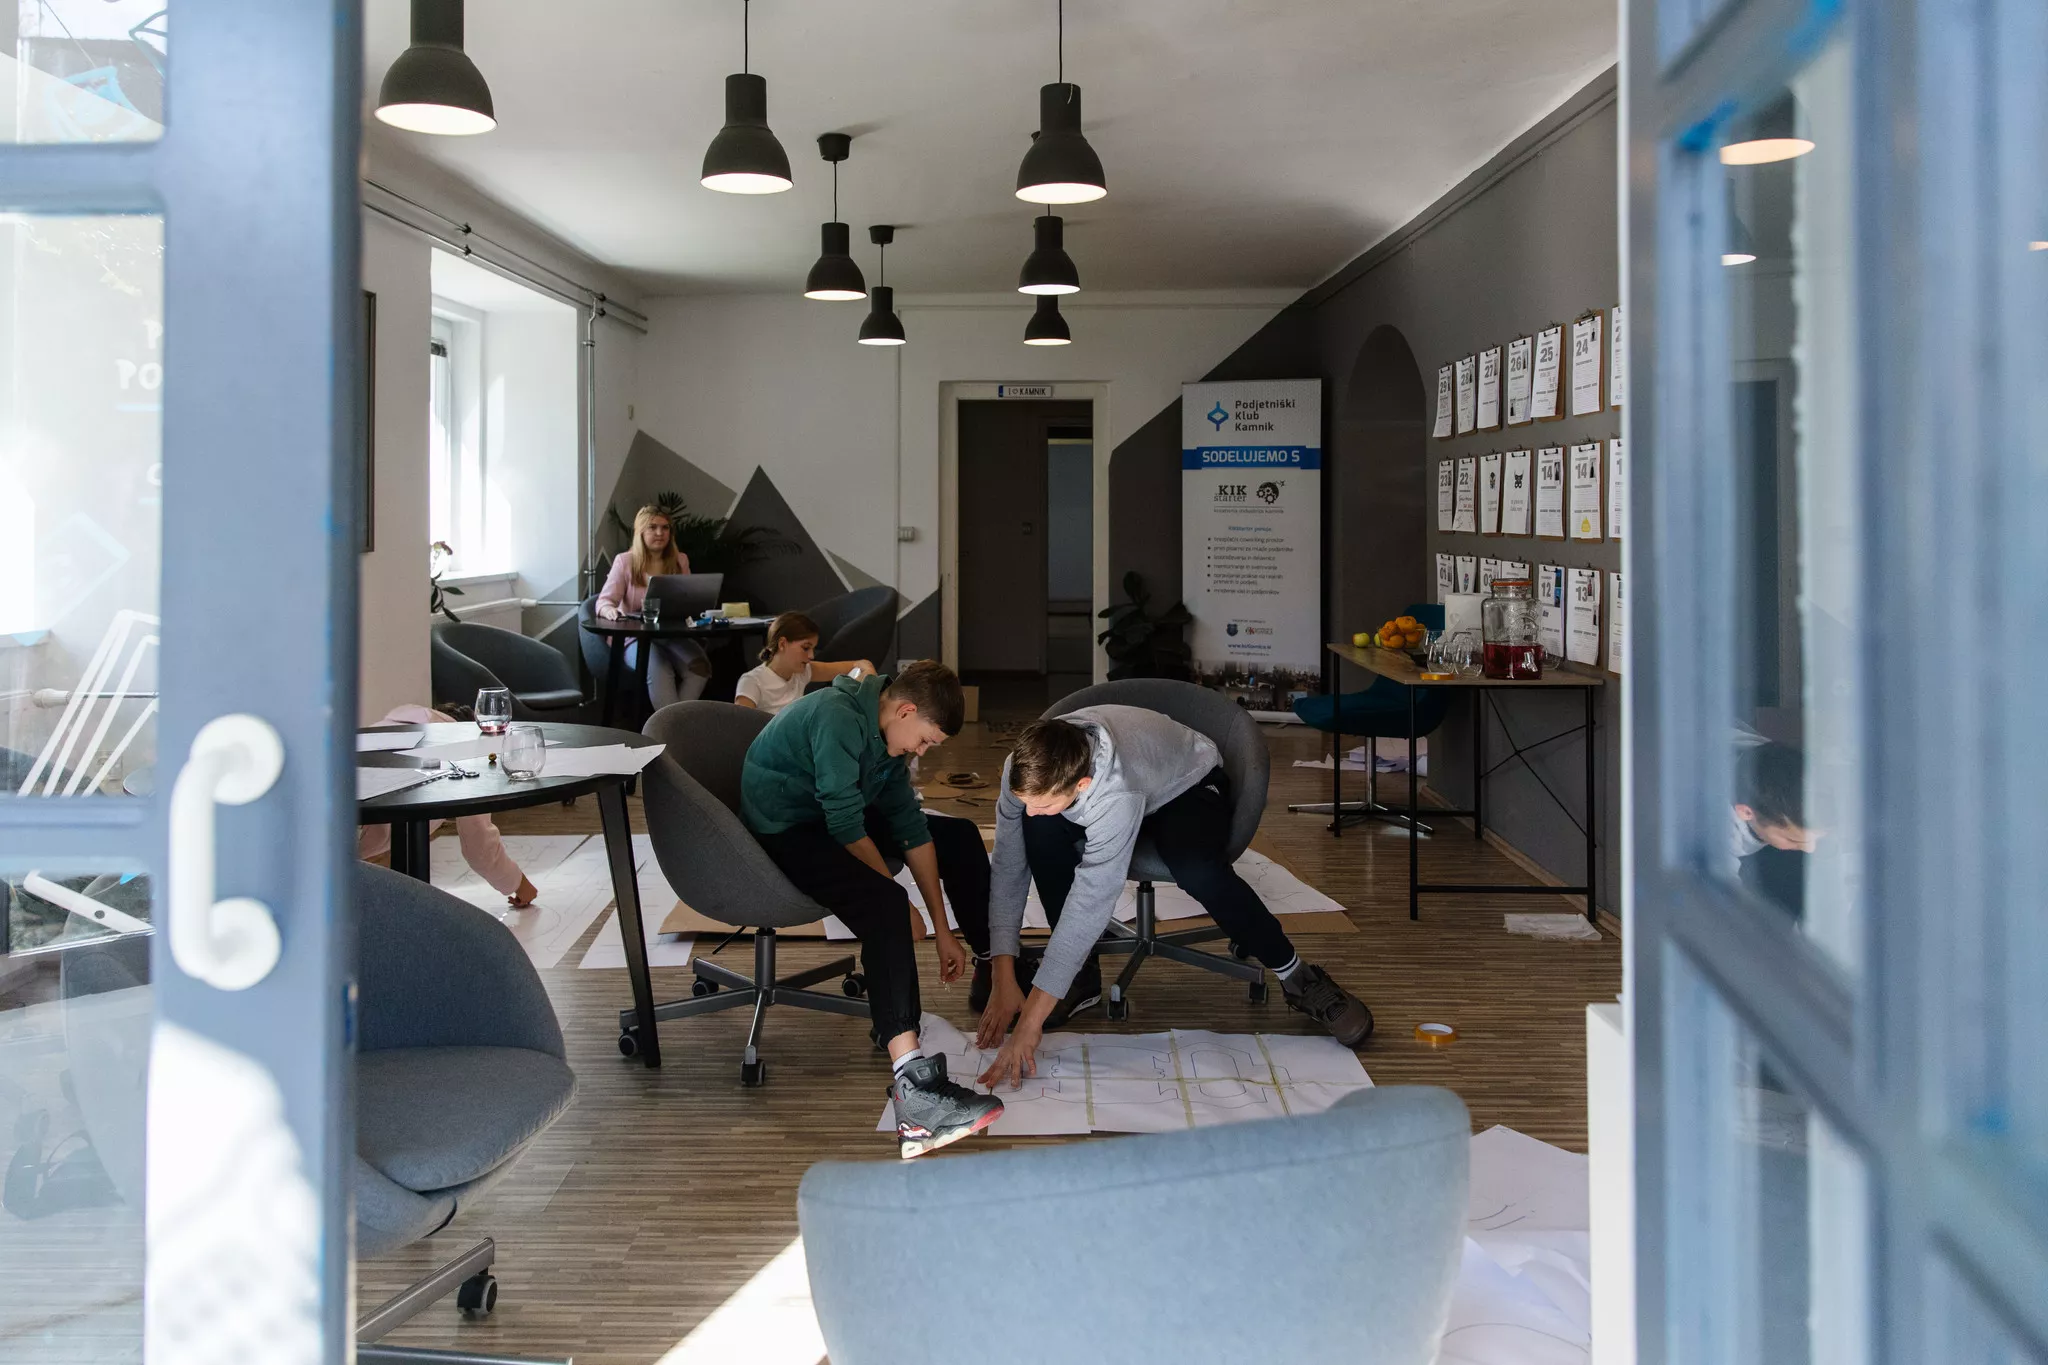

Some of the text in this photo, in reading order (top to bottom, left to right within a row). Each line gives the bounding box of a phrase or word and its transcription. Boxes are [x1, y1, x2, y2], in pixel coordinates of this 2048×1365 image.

[1539, 346, 1553, 363] 25
[1575, 338, 1588, 357] 24
[1484, 363, 1493, 378] 27
[1510, 355, 1521, 373] 26
[1020, 388, 1046, 396] KAMNIK
[1235, 399, 1296, 411] Podjetniški
[1235, 411, 1260, 421] Klub
[1235, 422, 1274, 432] Kamnik
[1202, 450, 1300, 463] SODELUJEMO S
[1541, 465, 1553, 481] 14
[1574, 463, 1588, 480] 14
[1459, 472, 1469, 486] 22
[1218, 485, 1247, 496] KIK
[1541, 581, 1551, 598] 12
